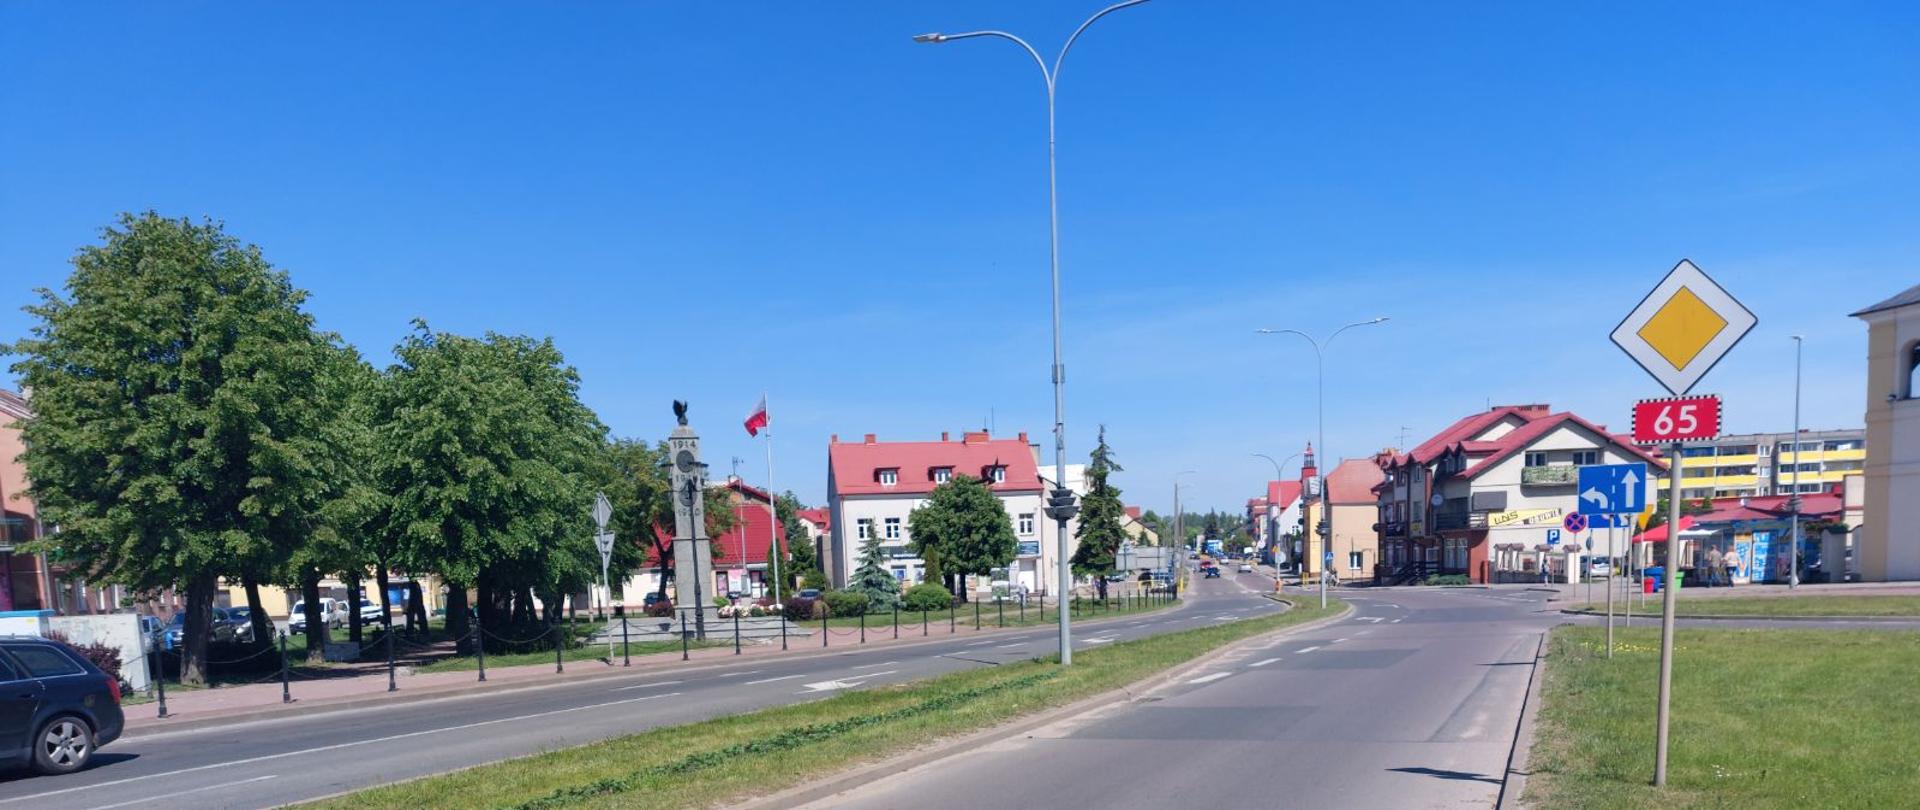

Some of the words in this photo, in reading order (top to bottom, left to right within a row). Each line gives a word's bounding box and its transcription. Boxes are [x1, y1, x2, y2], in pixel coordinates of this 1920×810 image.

[1654, 404, 1697, 435] 65
[673, 440, 696, 449] 1914
[1549, 530, 1558, 541] P
